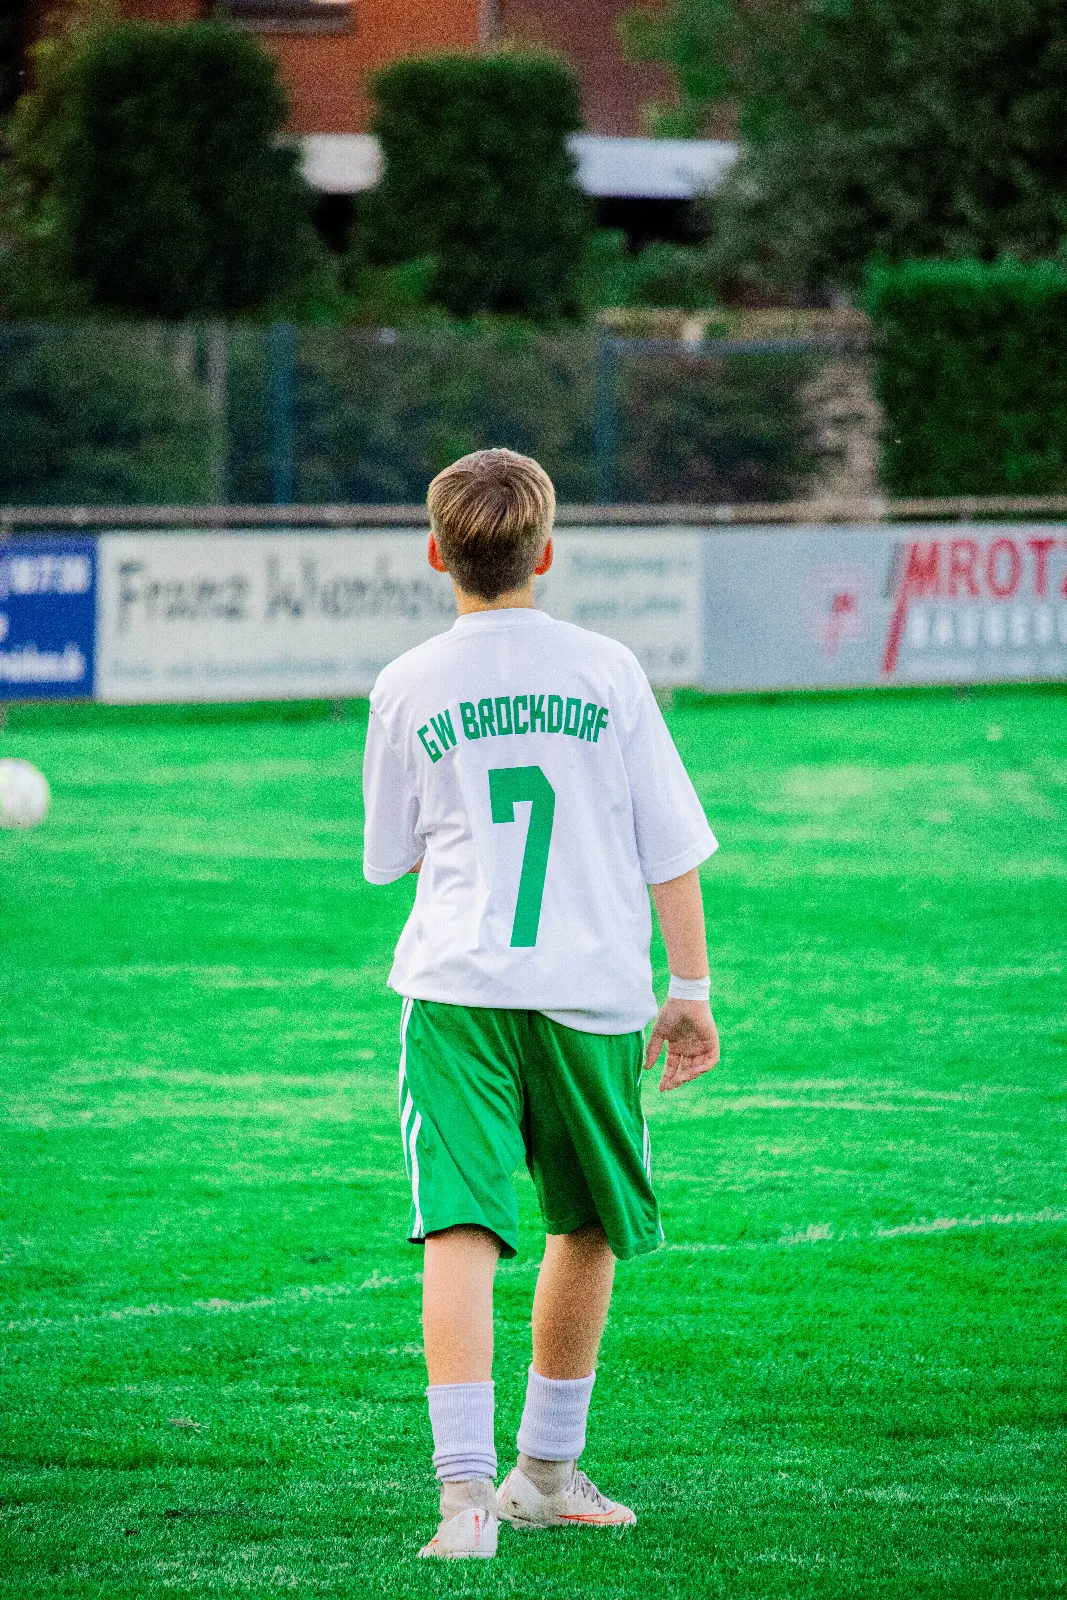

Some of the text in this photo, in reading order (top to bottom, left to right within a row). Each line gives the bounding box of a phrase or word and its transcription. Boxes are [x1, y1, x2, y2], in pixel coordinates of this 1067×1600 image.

[417, 694, 609, 764] GW BROCKDORF
[488, 765, 556, 948] 7
